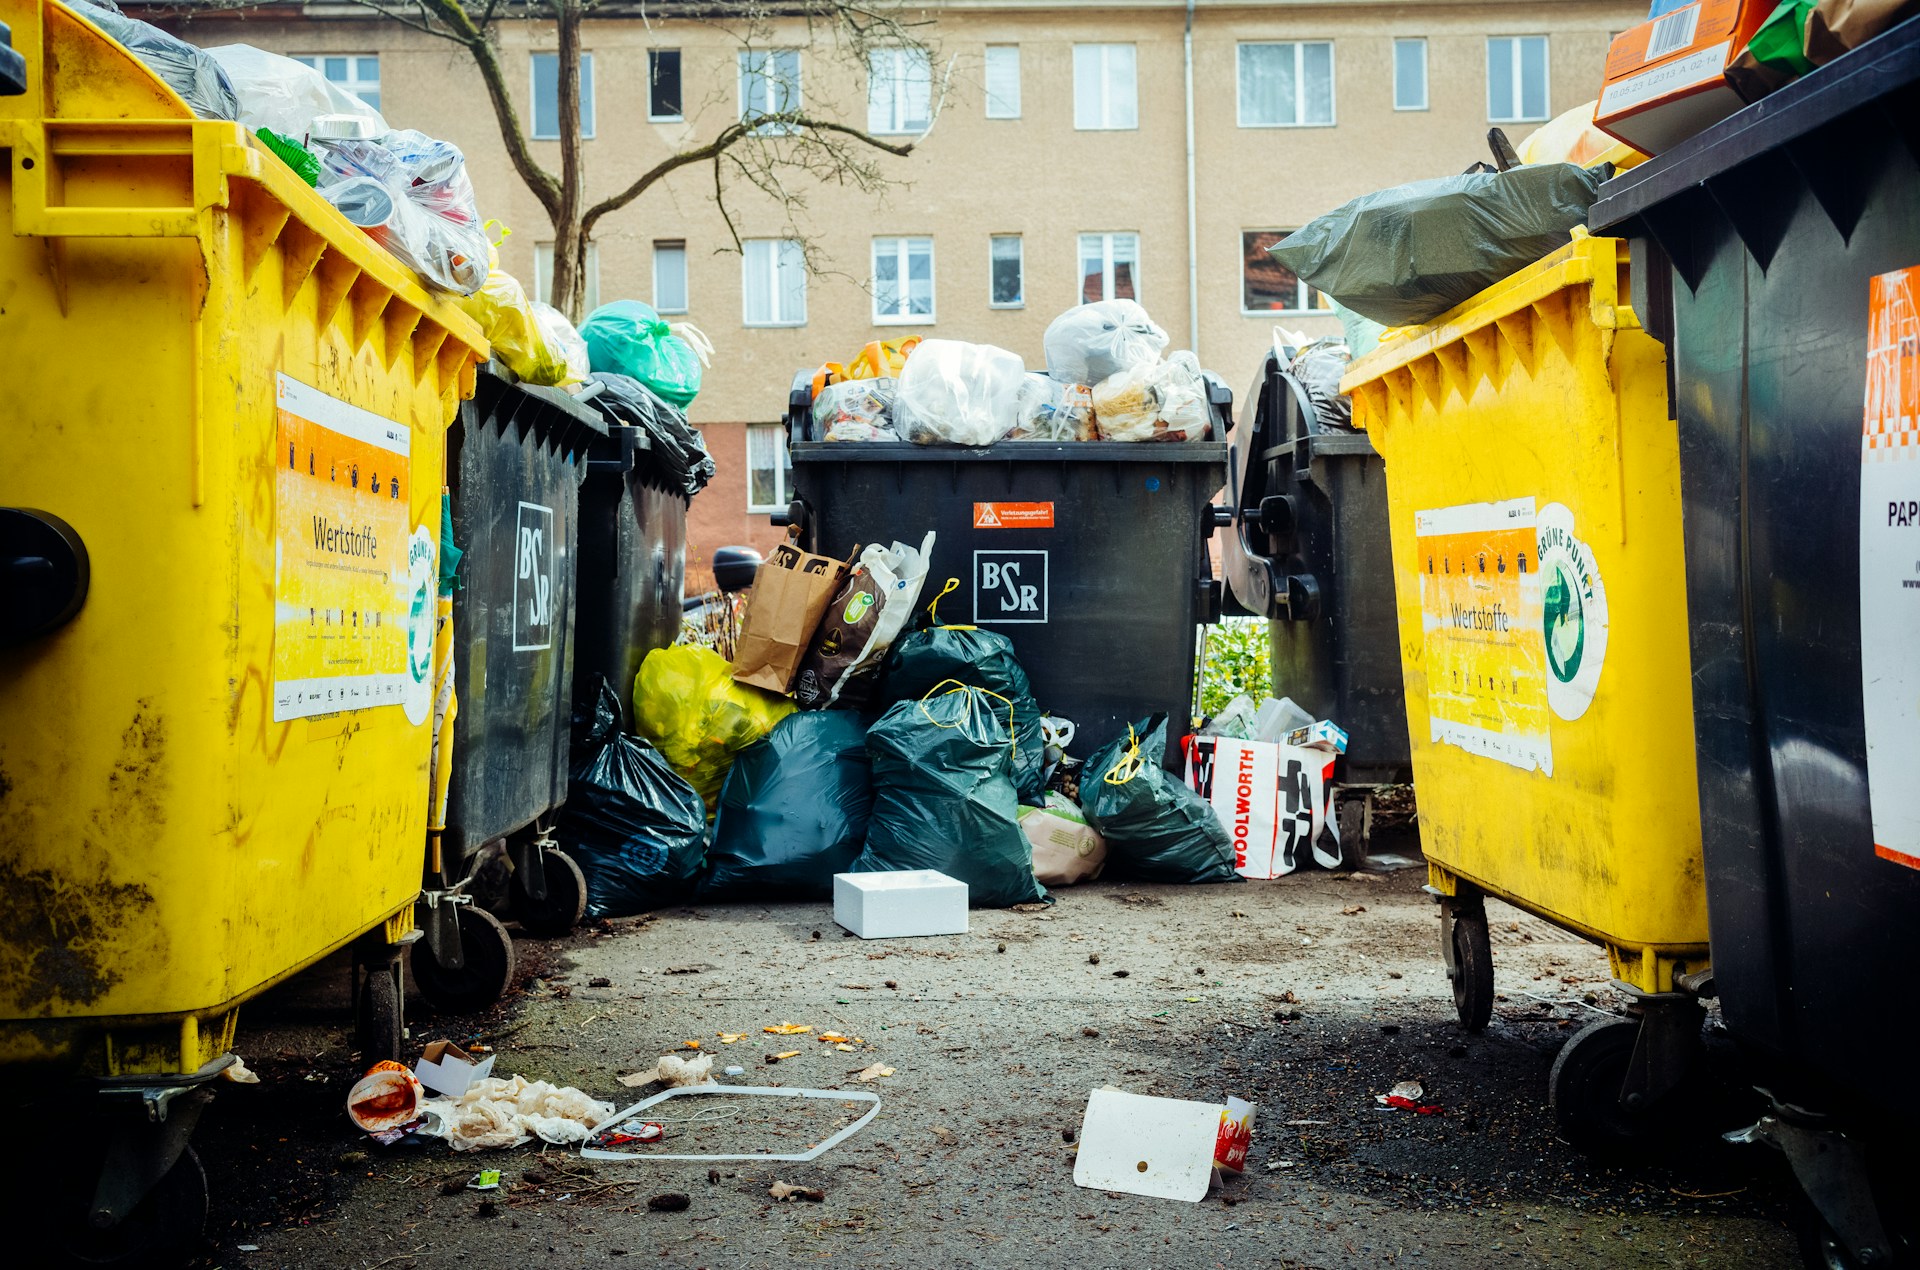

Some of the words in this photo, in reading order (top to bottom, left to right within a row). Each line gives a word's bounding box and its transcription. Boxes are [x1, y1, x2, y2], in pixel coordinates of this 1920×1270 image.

[1609, 81, 1643, 100] 10.05.23
[313, 515, 377, 559] Wertstoffe
[1888, 501, 1920, 527] PAP
[519, 527, 549, 626] BSR
[1537, 525, 1563, 562] GRÜNE
[1566, 535, 1593, 601] PUNKT
[982, 562, 1039, 612] BSR
[1450, 602, 1509, 633] Wertstoffe
[1234, 748, 1255, 869] WOOLWORTH
